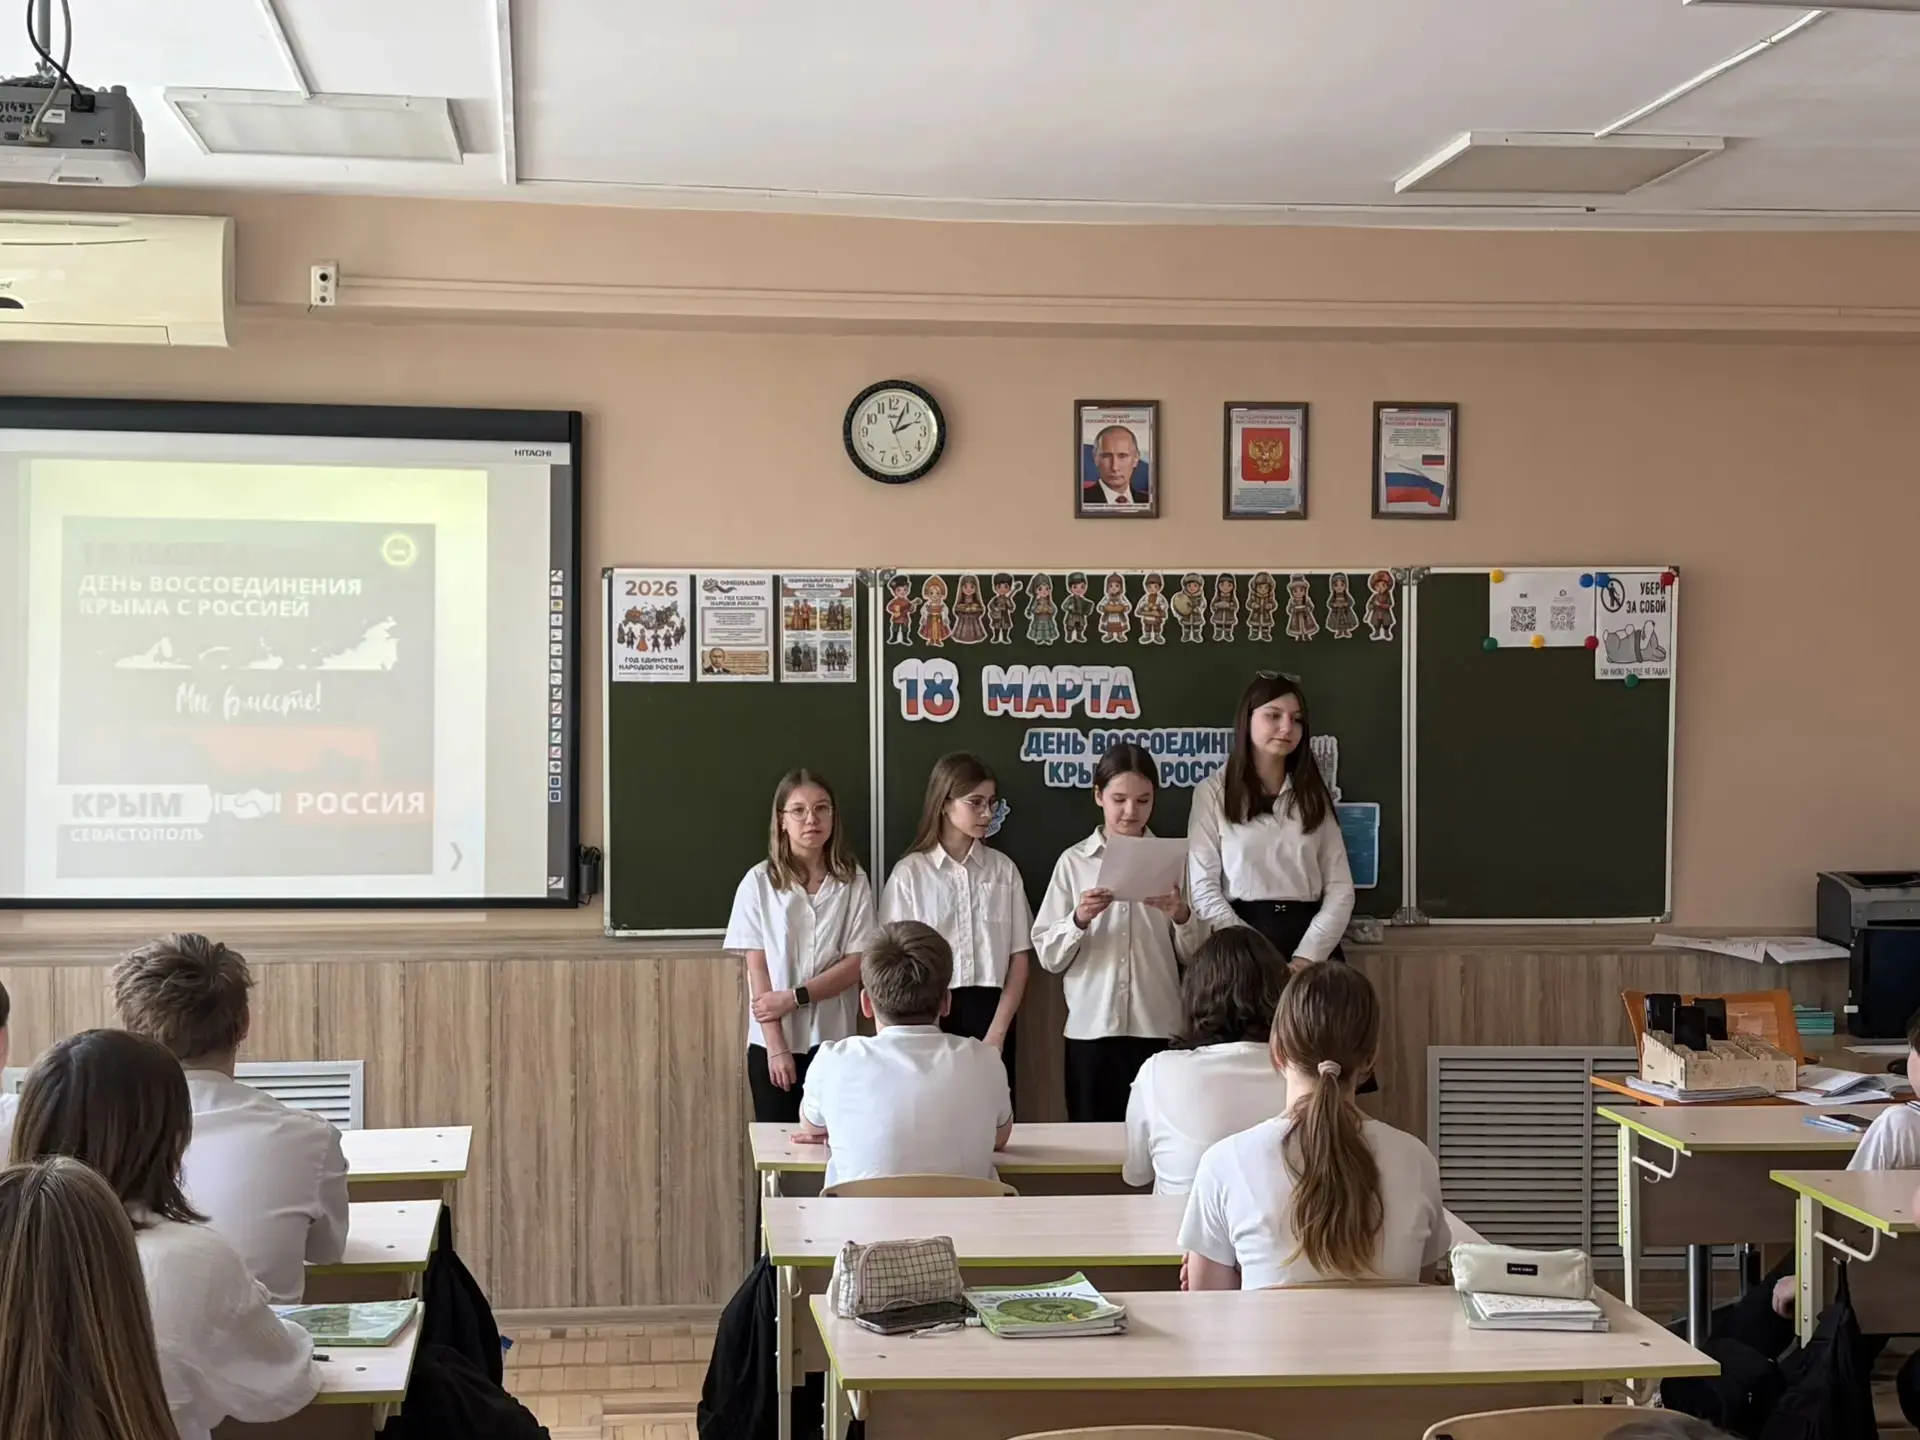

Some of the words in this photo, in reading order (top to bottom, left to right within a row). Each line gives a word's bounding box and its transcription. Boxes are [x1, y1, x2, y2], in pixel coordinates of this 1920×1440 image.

[877, 402, 885, 414] 11
[888, 398, 899, 410] 12
[906, 402, 910, 414] 1
[867, 413, 877, 425] 10
[914, 412, 922, 424] 2
[861, 427, 869, 438] 9
[919, 426, 928, 438] 3
[866, 441, 875, 453] 8
[914, 440, 922, 452] 4
[514, 449, 552, 457] HITACHI
[879, 450, 887, 463] 7
[904, 451, 912, 462] 5
[891, 454, 899, 465] 6
[79, 575, 142, 596] ДЕНЬ
[150, 576, 362, 598] ВОССОЕДИНЕНИЯ
[625, 580, 678, 597] 2026
[1640, 581, 1666, 595] УБЕРИ
[80, 598, 169, 616] КРЫМА
[177, 599, 191, 616] С
[198, 595, 309, 617] РОССИЕЙ
[1626, 601, 1637, 613] ЗА
[1640, 597, 1666, 613] СОБОЙ
[897, 661, 956, 717] 18
[986, 668, 1136, 714] МАРТА
[176, 681, 211, 714] Мы
[223, 682, 322, 722] вместе!
[1025, 731, 1086, 757] ДЕНЬ
[1161, 761, 1224, 785] РОСС
[71, 792, 184, 819] КРЫМ
[296, 792, 426, 815] РОССИЯ
[69, 827, 205, 842] СЕВАСТОПОЛЬ
